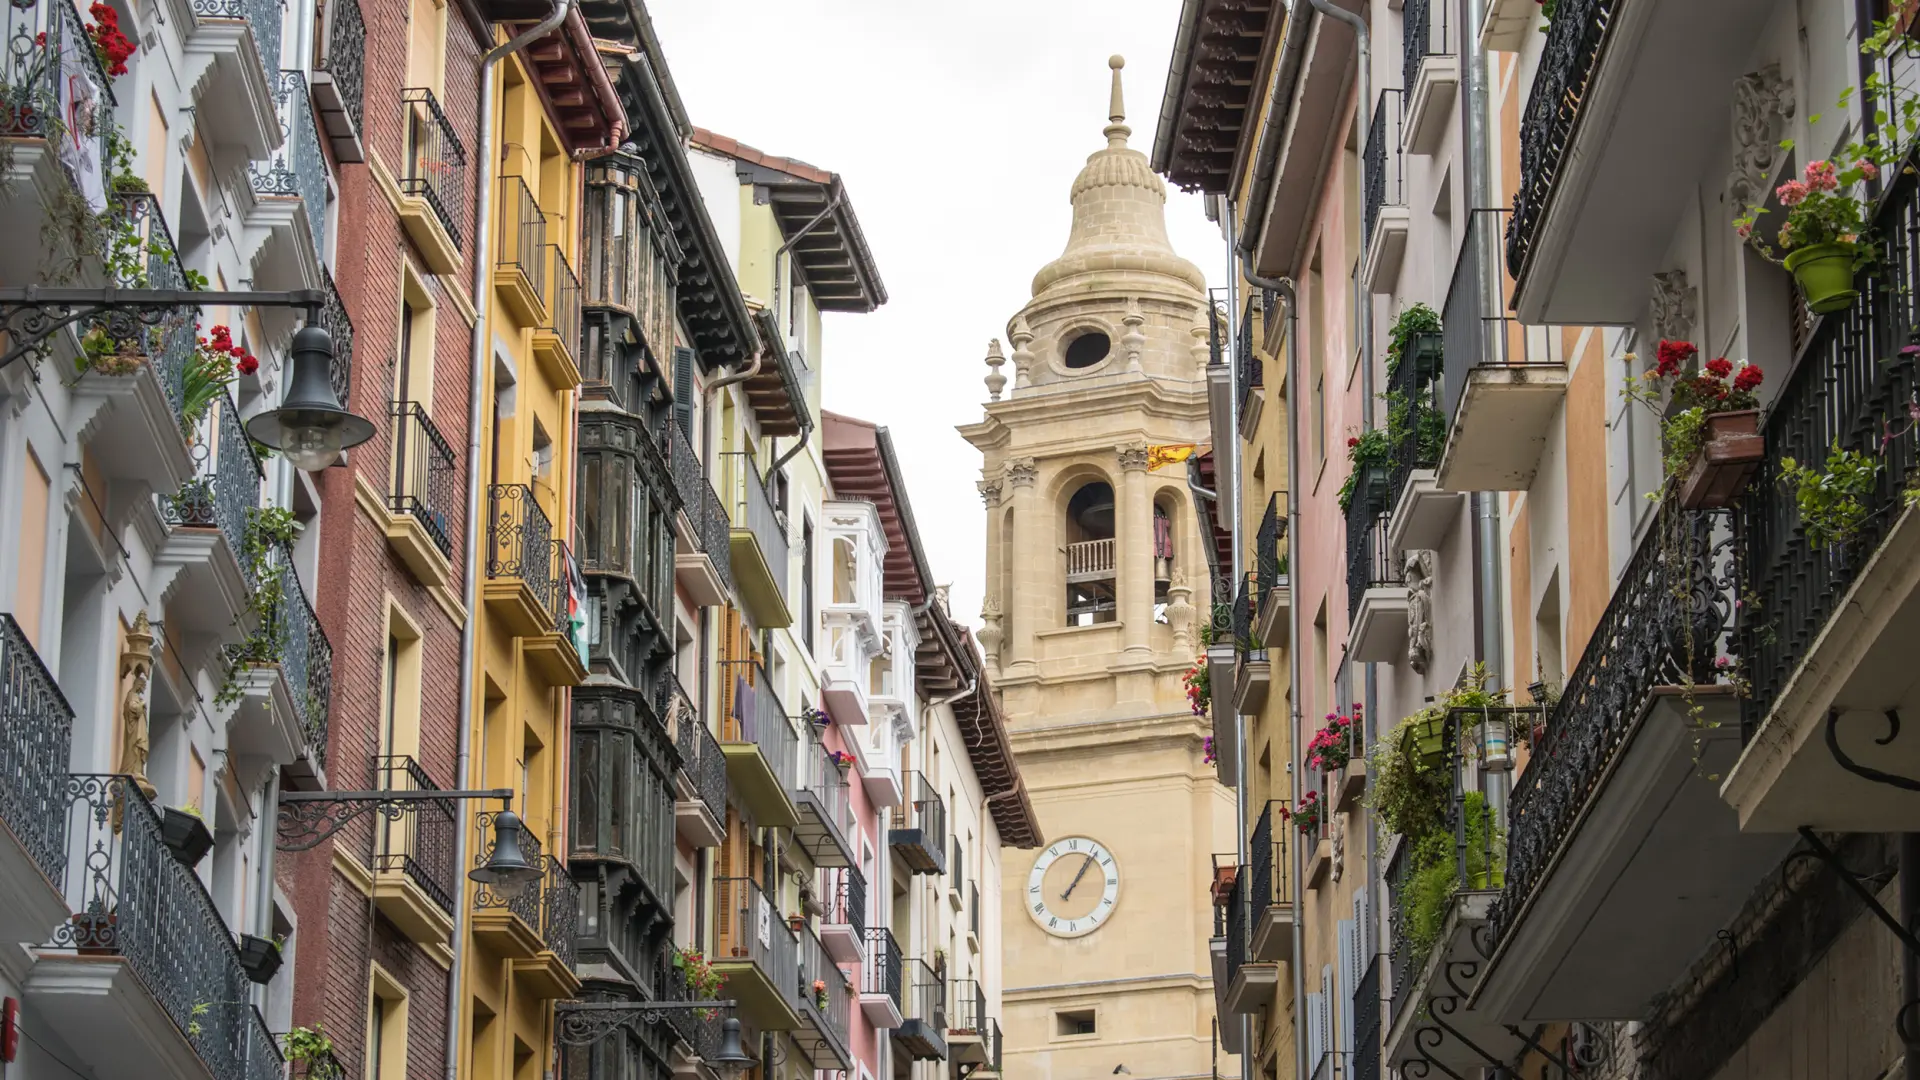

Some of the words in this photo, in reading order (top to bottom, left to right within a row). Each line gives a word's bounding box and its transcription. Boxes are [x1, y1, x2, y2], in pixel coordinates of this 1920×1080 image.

[1068, 839, 1077, 850] XII
[1049, 846, 1059, 858] XI
[1101, 857, 1112, 866] II
[1034, 864, 1045, 873] X
